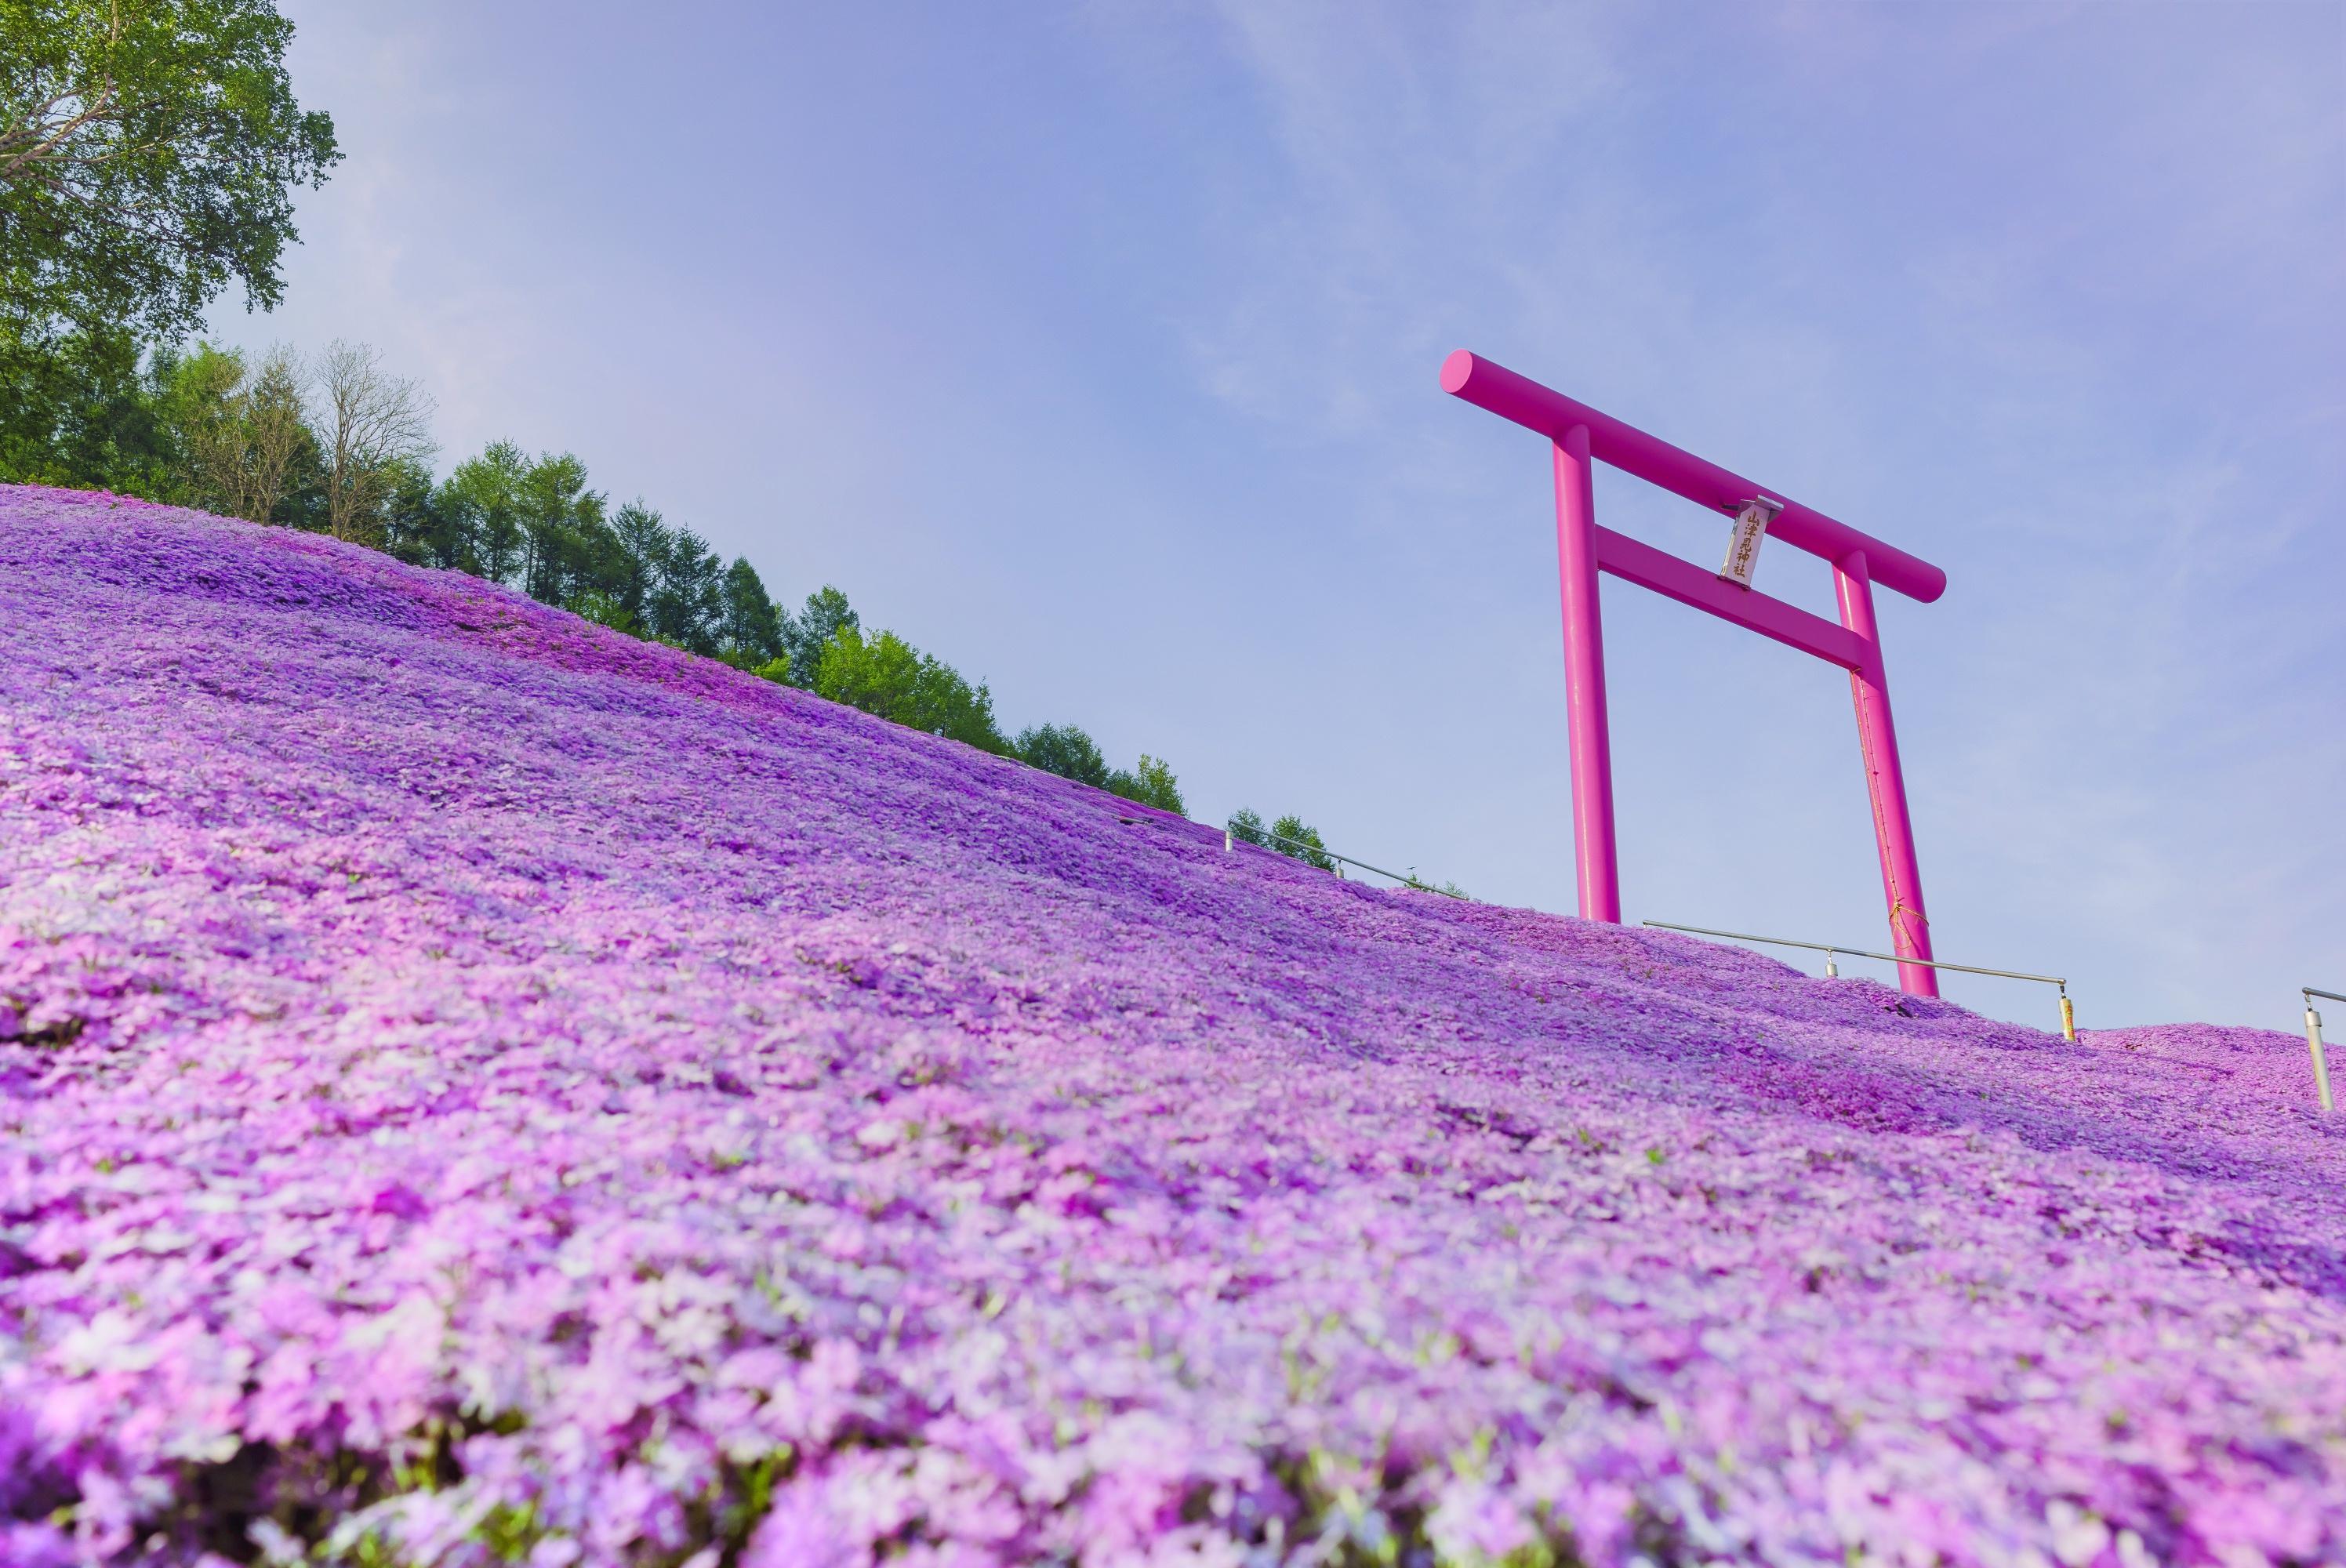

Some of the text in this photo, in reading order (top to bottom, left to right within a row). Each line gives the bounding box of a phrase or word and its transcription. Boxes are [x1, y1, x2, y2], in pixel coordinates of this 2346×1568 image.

[1734, 510, 1760, 578] 山津見神社
